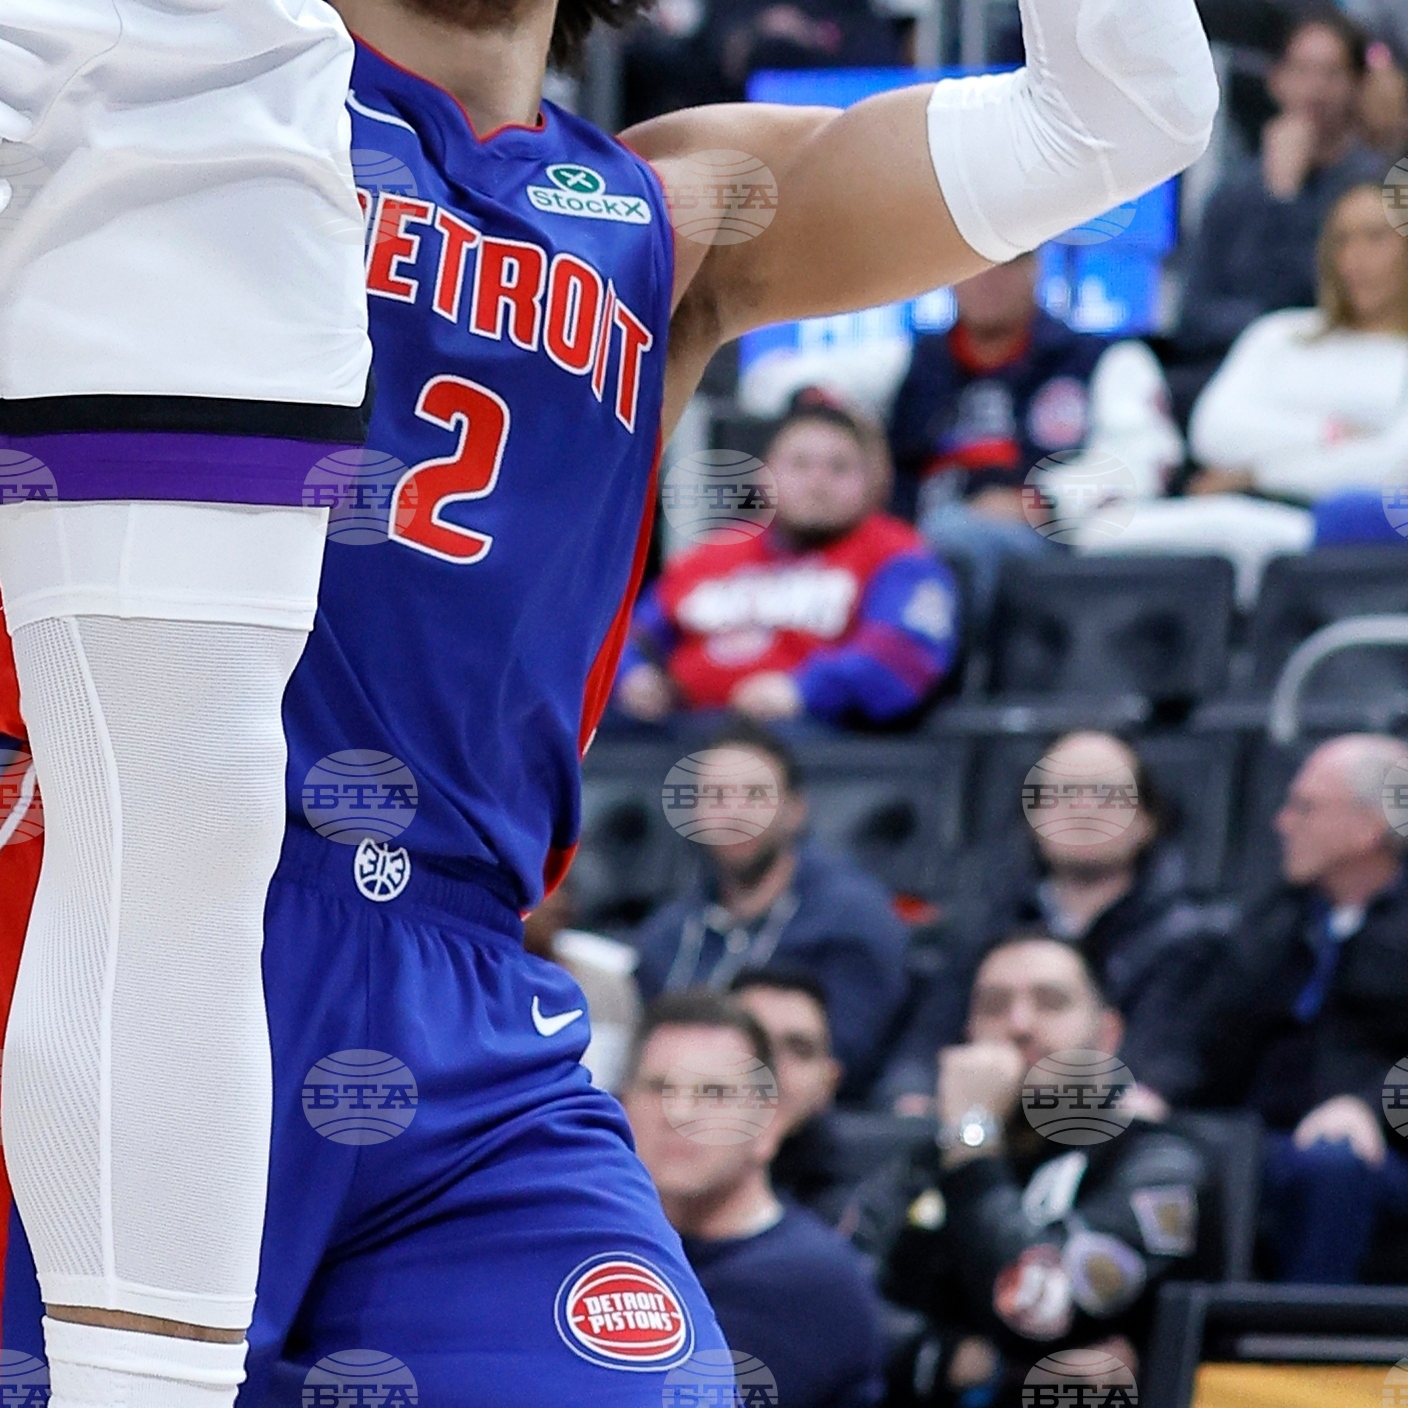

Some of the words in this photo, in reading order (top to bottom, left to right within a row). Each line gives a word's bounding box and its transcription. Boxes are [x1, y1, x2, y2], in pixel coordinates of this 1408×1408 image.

[356, 186, 653, 435] ETROIT
[388, 373, 511, 565] 2
[582, 1291, 666, 1316] DETROIT
[587, 1310, 673, 1335] PISTONS
